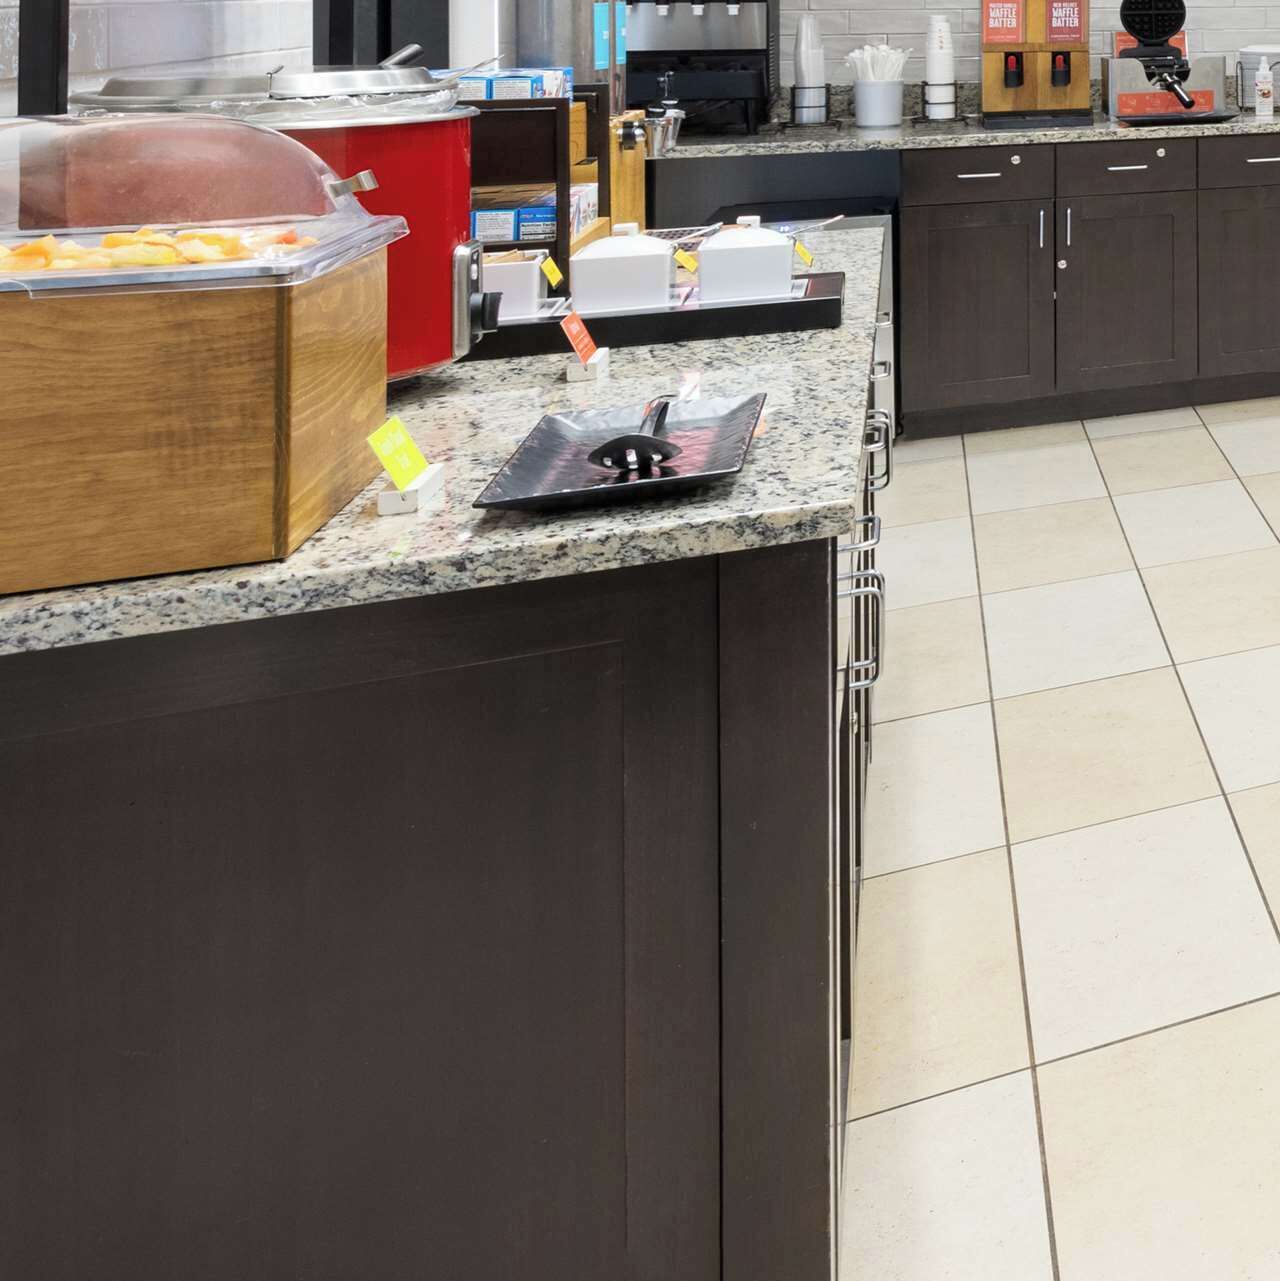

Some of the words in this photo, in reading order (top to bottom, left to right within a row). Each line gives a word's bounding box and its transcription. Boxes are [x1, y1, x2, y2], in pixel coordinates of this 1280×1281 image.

[989, 7, 1016, 17] WAFFLE
[1052, 7, 1079, 17] WAFFLE
[989, 17, 1016, 28] BATTER
[1052, 17, 1079, 27] BATTER
